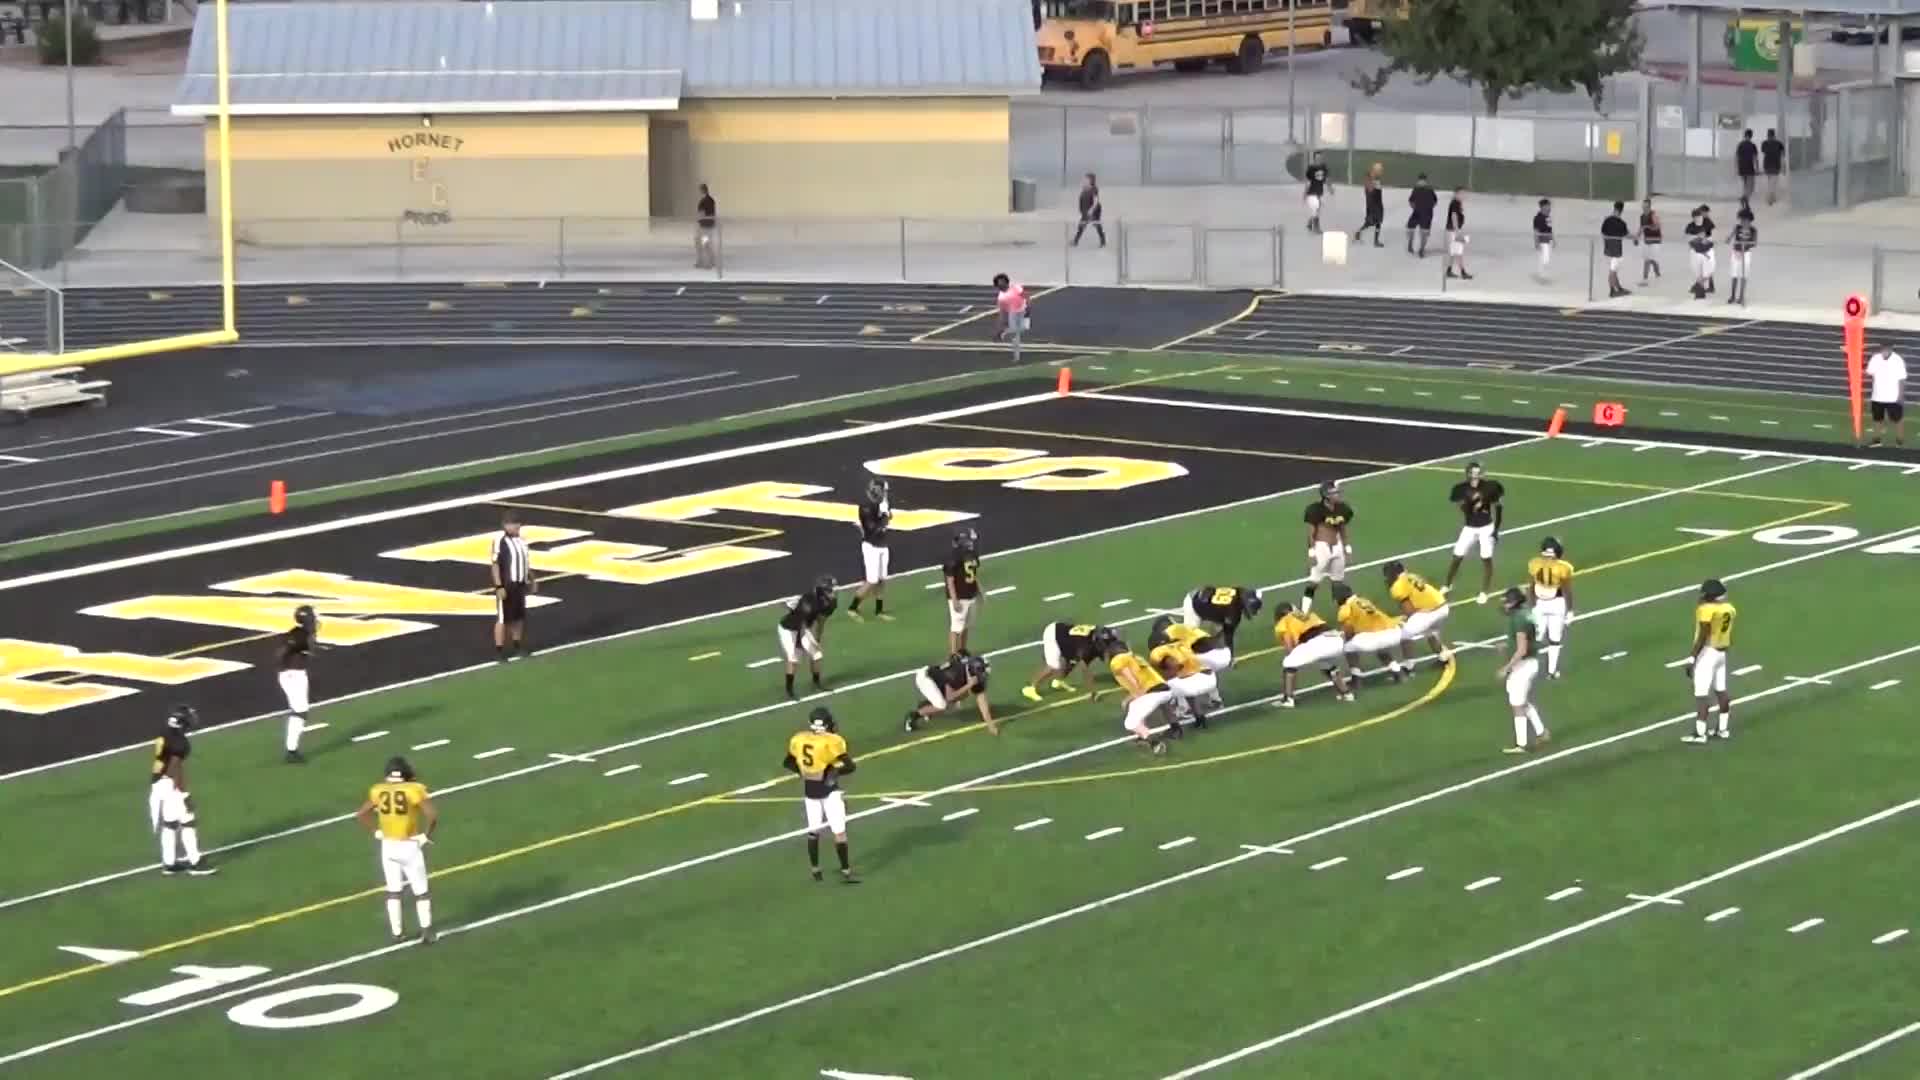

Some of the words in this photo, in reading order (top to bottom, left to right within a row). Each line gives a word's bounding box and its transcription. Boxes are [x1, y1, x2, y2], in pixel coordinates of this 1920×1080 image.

[387, 133, 464, 152] HORNET
[1602, 405, 1613, 420] G
[802, 744, 814, 767] 5
[379, 790, 408, 815] 39
